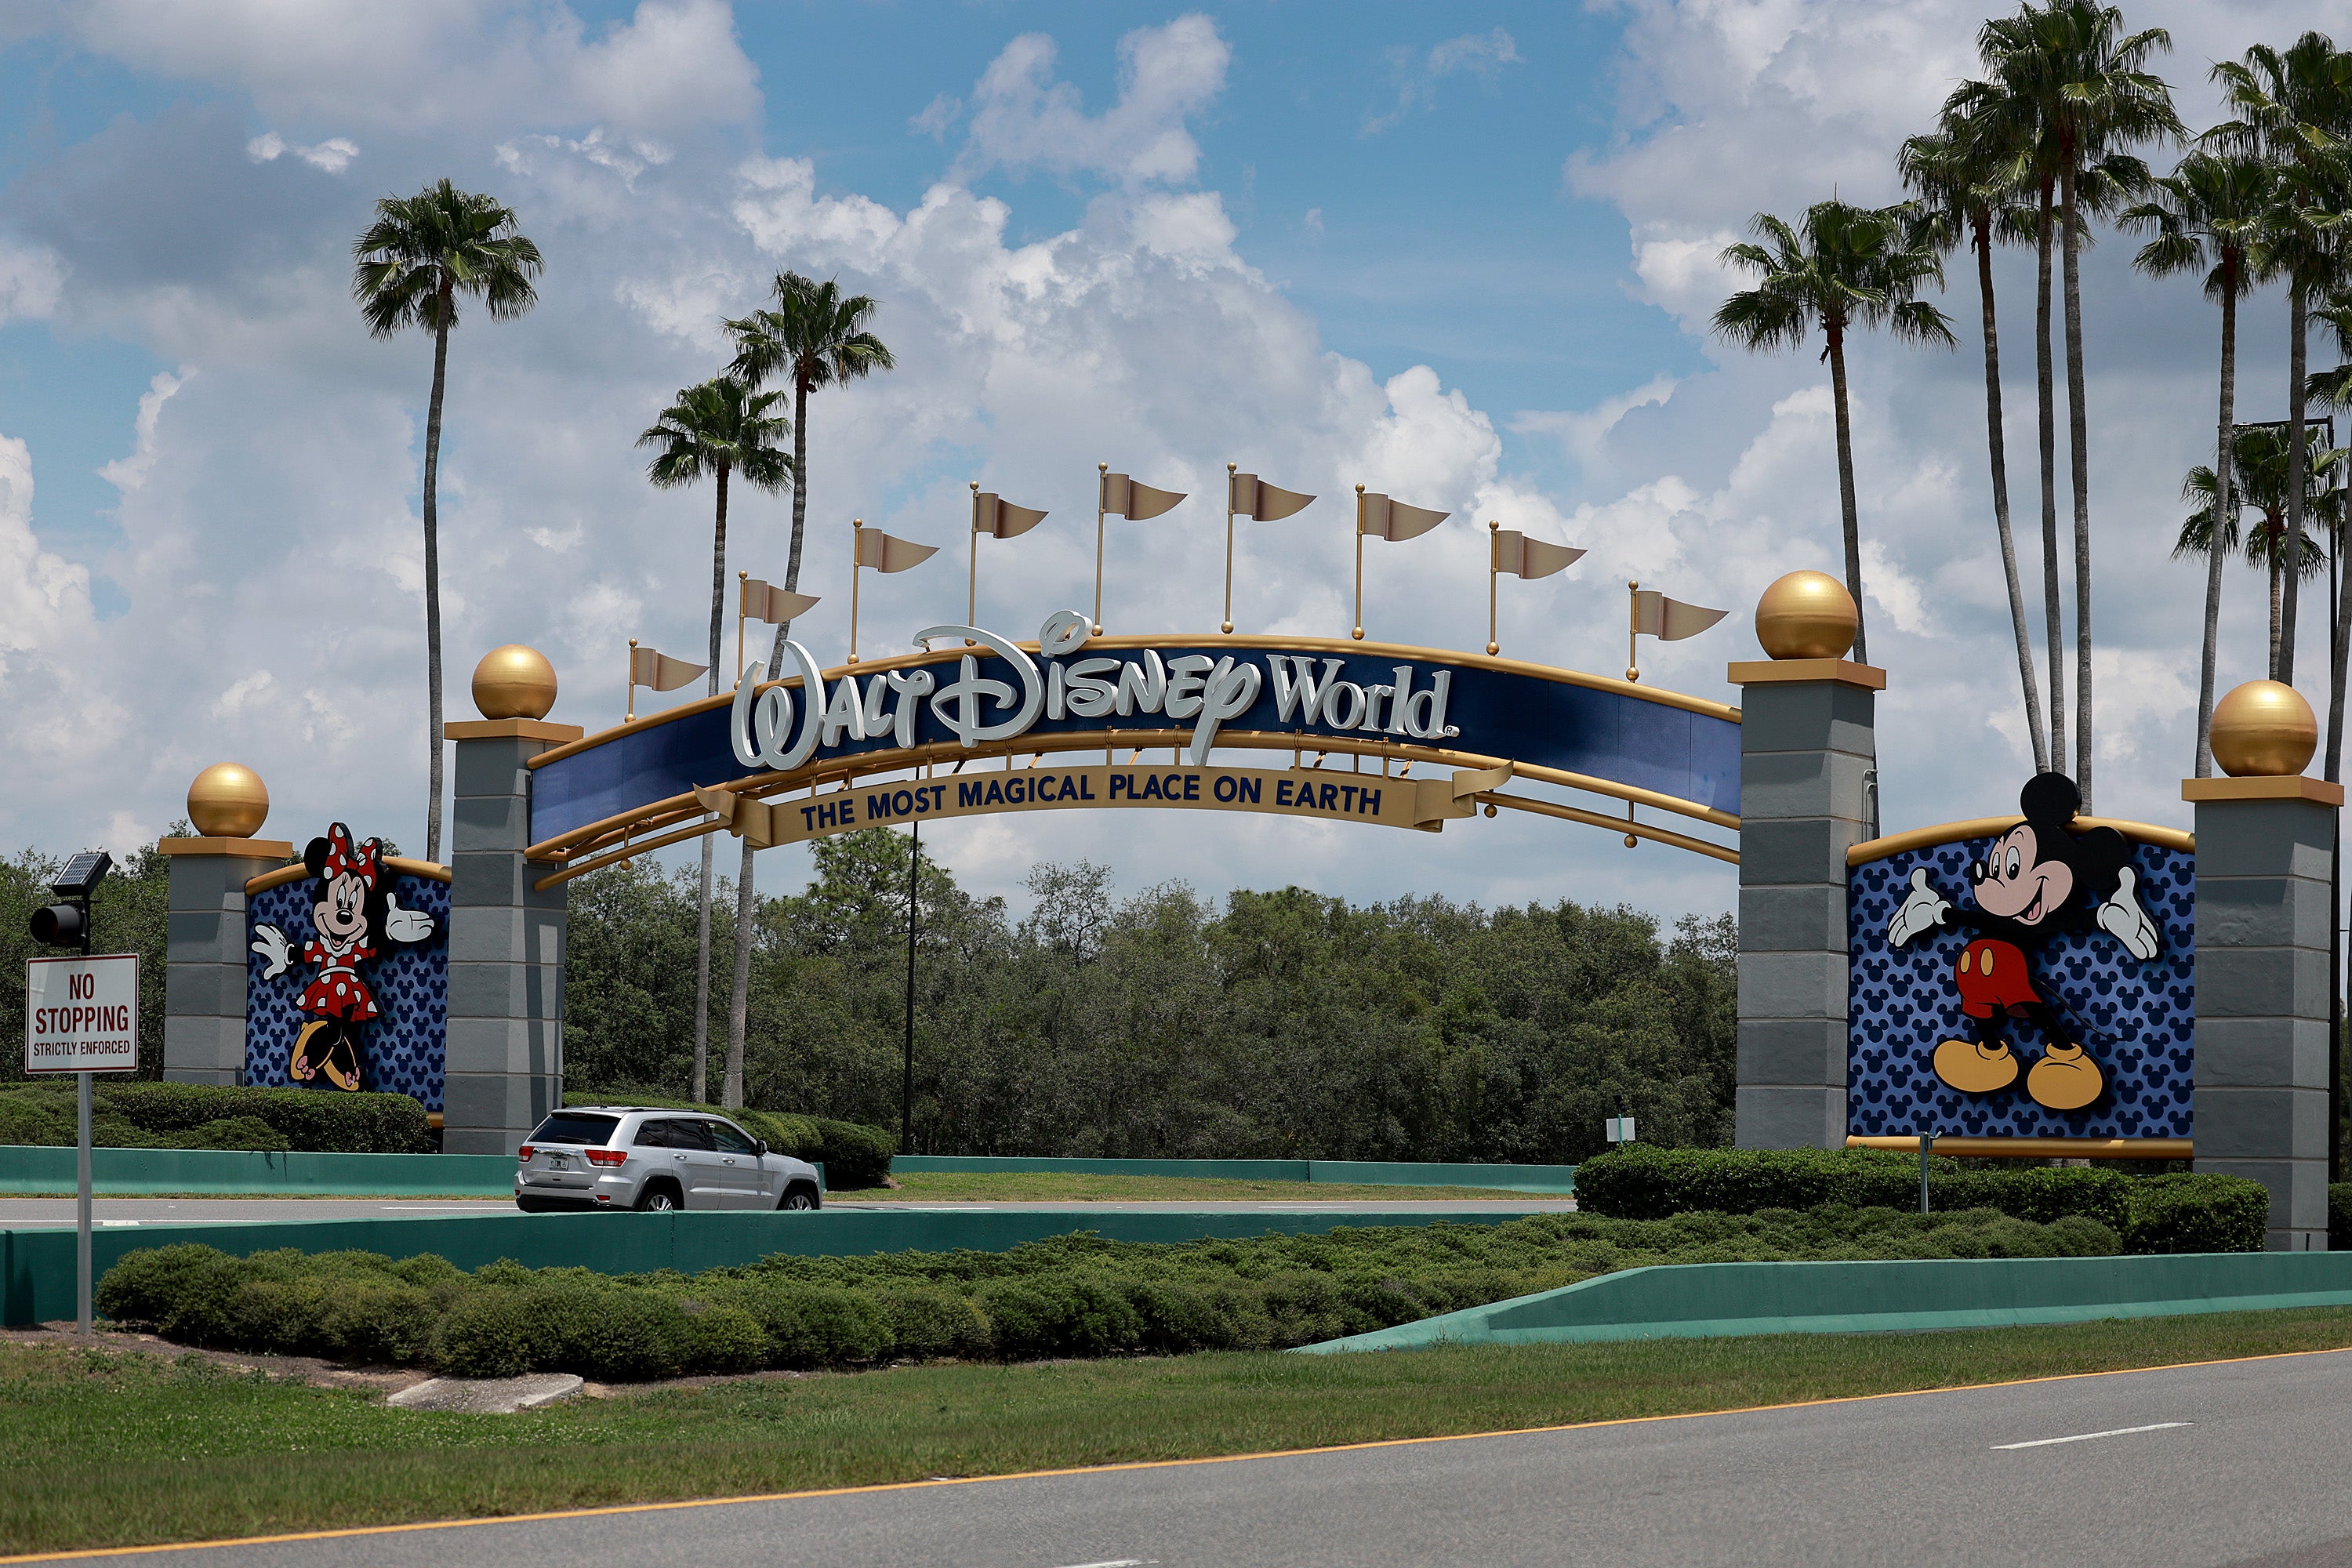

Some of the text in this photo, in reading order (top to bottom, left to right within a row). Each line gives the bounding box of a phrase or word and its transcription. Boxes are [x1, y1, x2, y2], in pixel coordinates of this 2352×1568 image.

[800, 774, 1381, 831] THE MOST MAGICAL PLACE ON EARTH
[69, 973, 94, 1000] NO
[35, 1004, 129, 1034] STOPPING
[33, 1040, 130, 1056] STRICTLY ENFORCED
